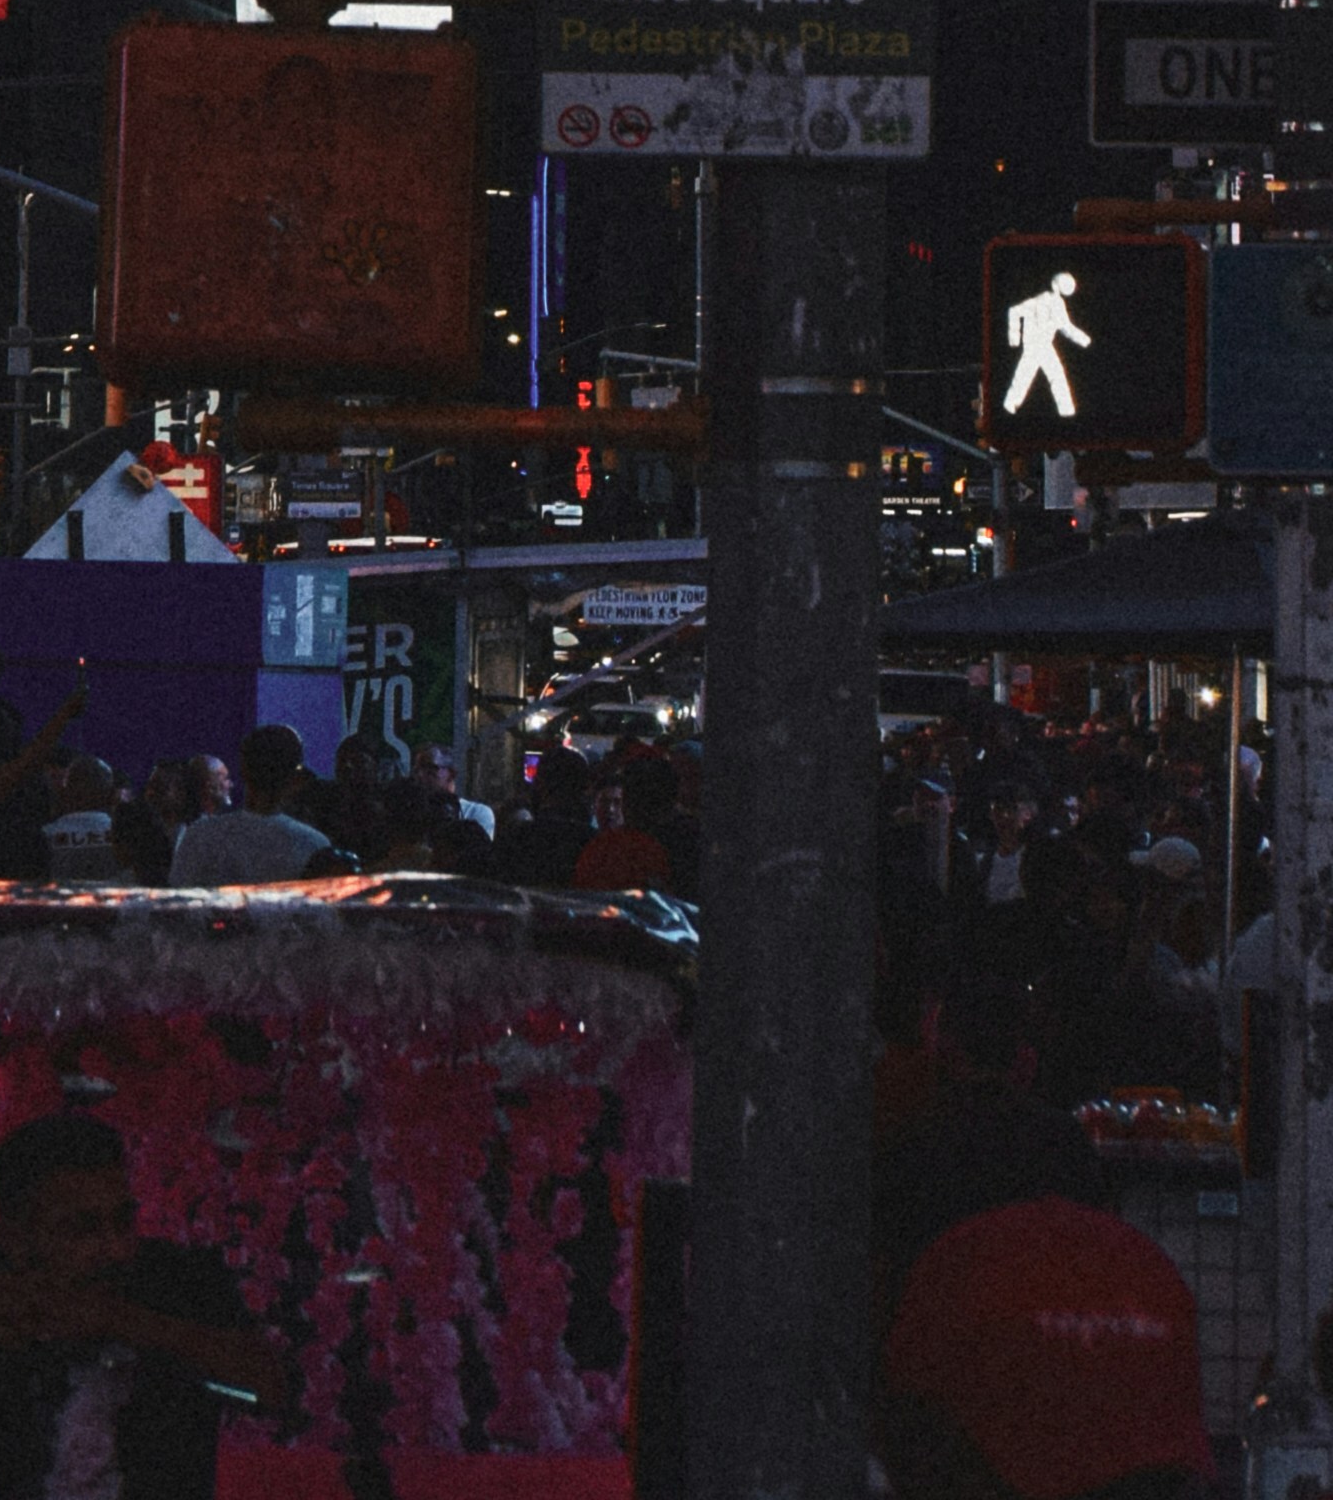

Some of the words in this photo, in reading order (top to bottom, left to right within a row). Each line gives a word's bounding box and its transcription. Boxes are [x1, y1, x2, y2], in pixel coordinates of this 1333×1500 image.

[799, 19, 912, 57] Plaza
[682, 590, 707, 603] ZONE
[588, 605, 612, 619] KEEP
[615, 606, 654, 620] MOVING
